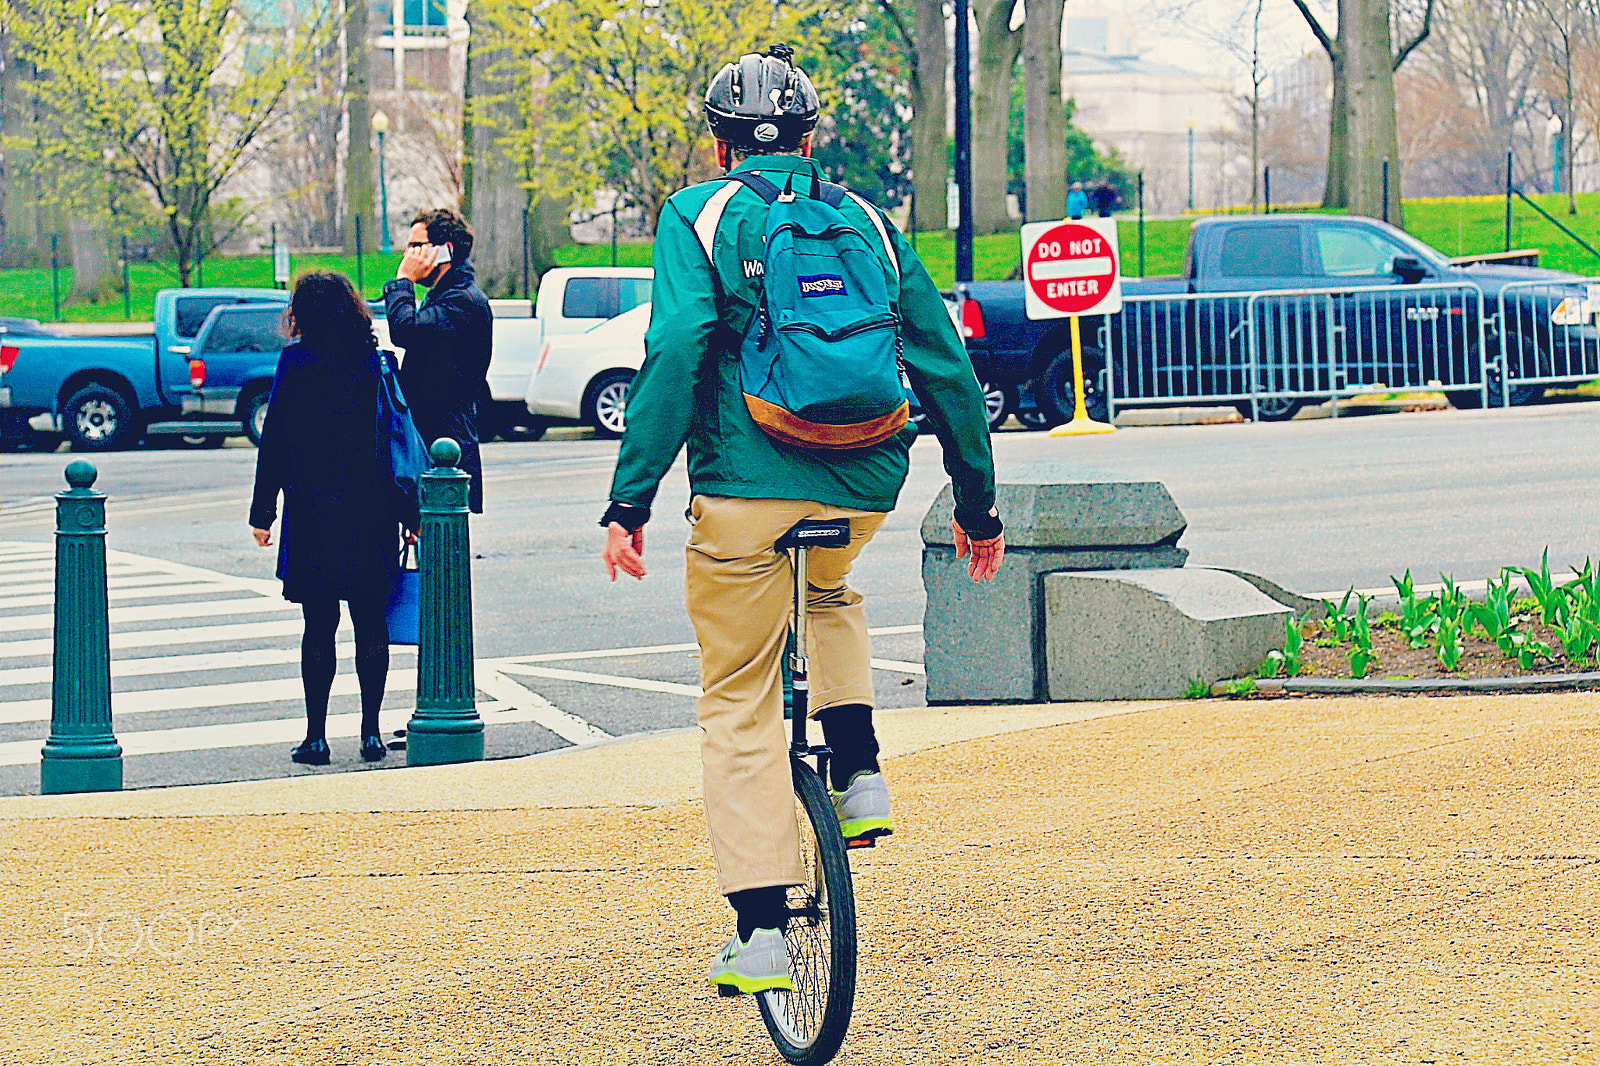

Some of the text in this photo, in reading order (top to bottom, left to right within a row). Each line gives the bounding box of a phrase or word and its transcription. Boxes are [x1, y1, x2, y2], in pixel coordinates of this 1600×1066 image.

[1038, 238, 1101, 258] DO NOT
[1046, 279, 1099, 298] ENTER
